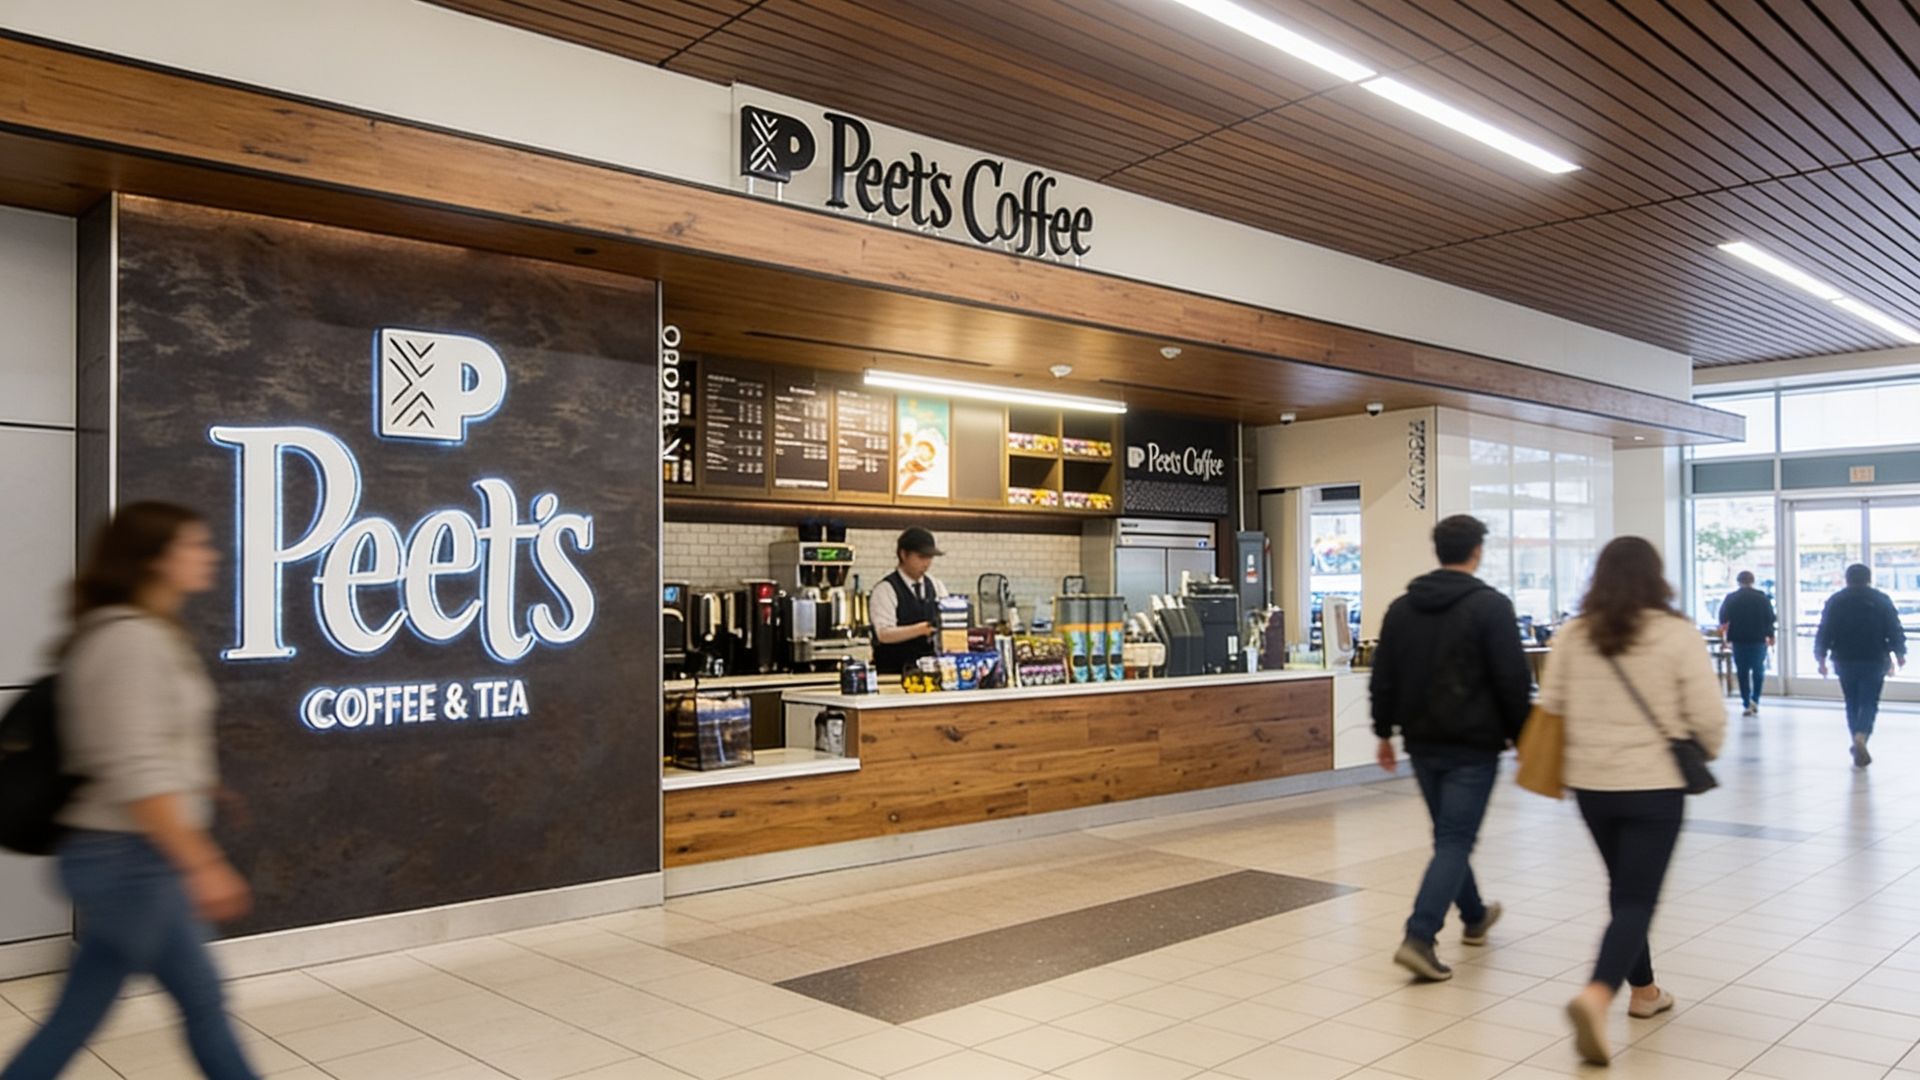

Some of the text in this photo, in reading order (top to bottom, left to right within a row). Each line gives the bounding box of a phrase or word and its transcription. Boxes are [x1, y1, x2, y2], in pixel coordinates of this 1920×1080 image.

[823, 112, 952, 229] Peet's
[962, 158, 1093, 257] Coffee
[209, 426, 596, 662] Peet's
[302, 678, 530, 730] COFFEE & TEA
